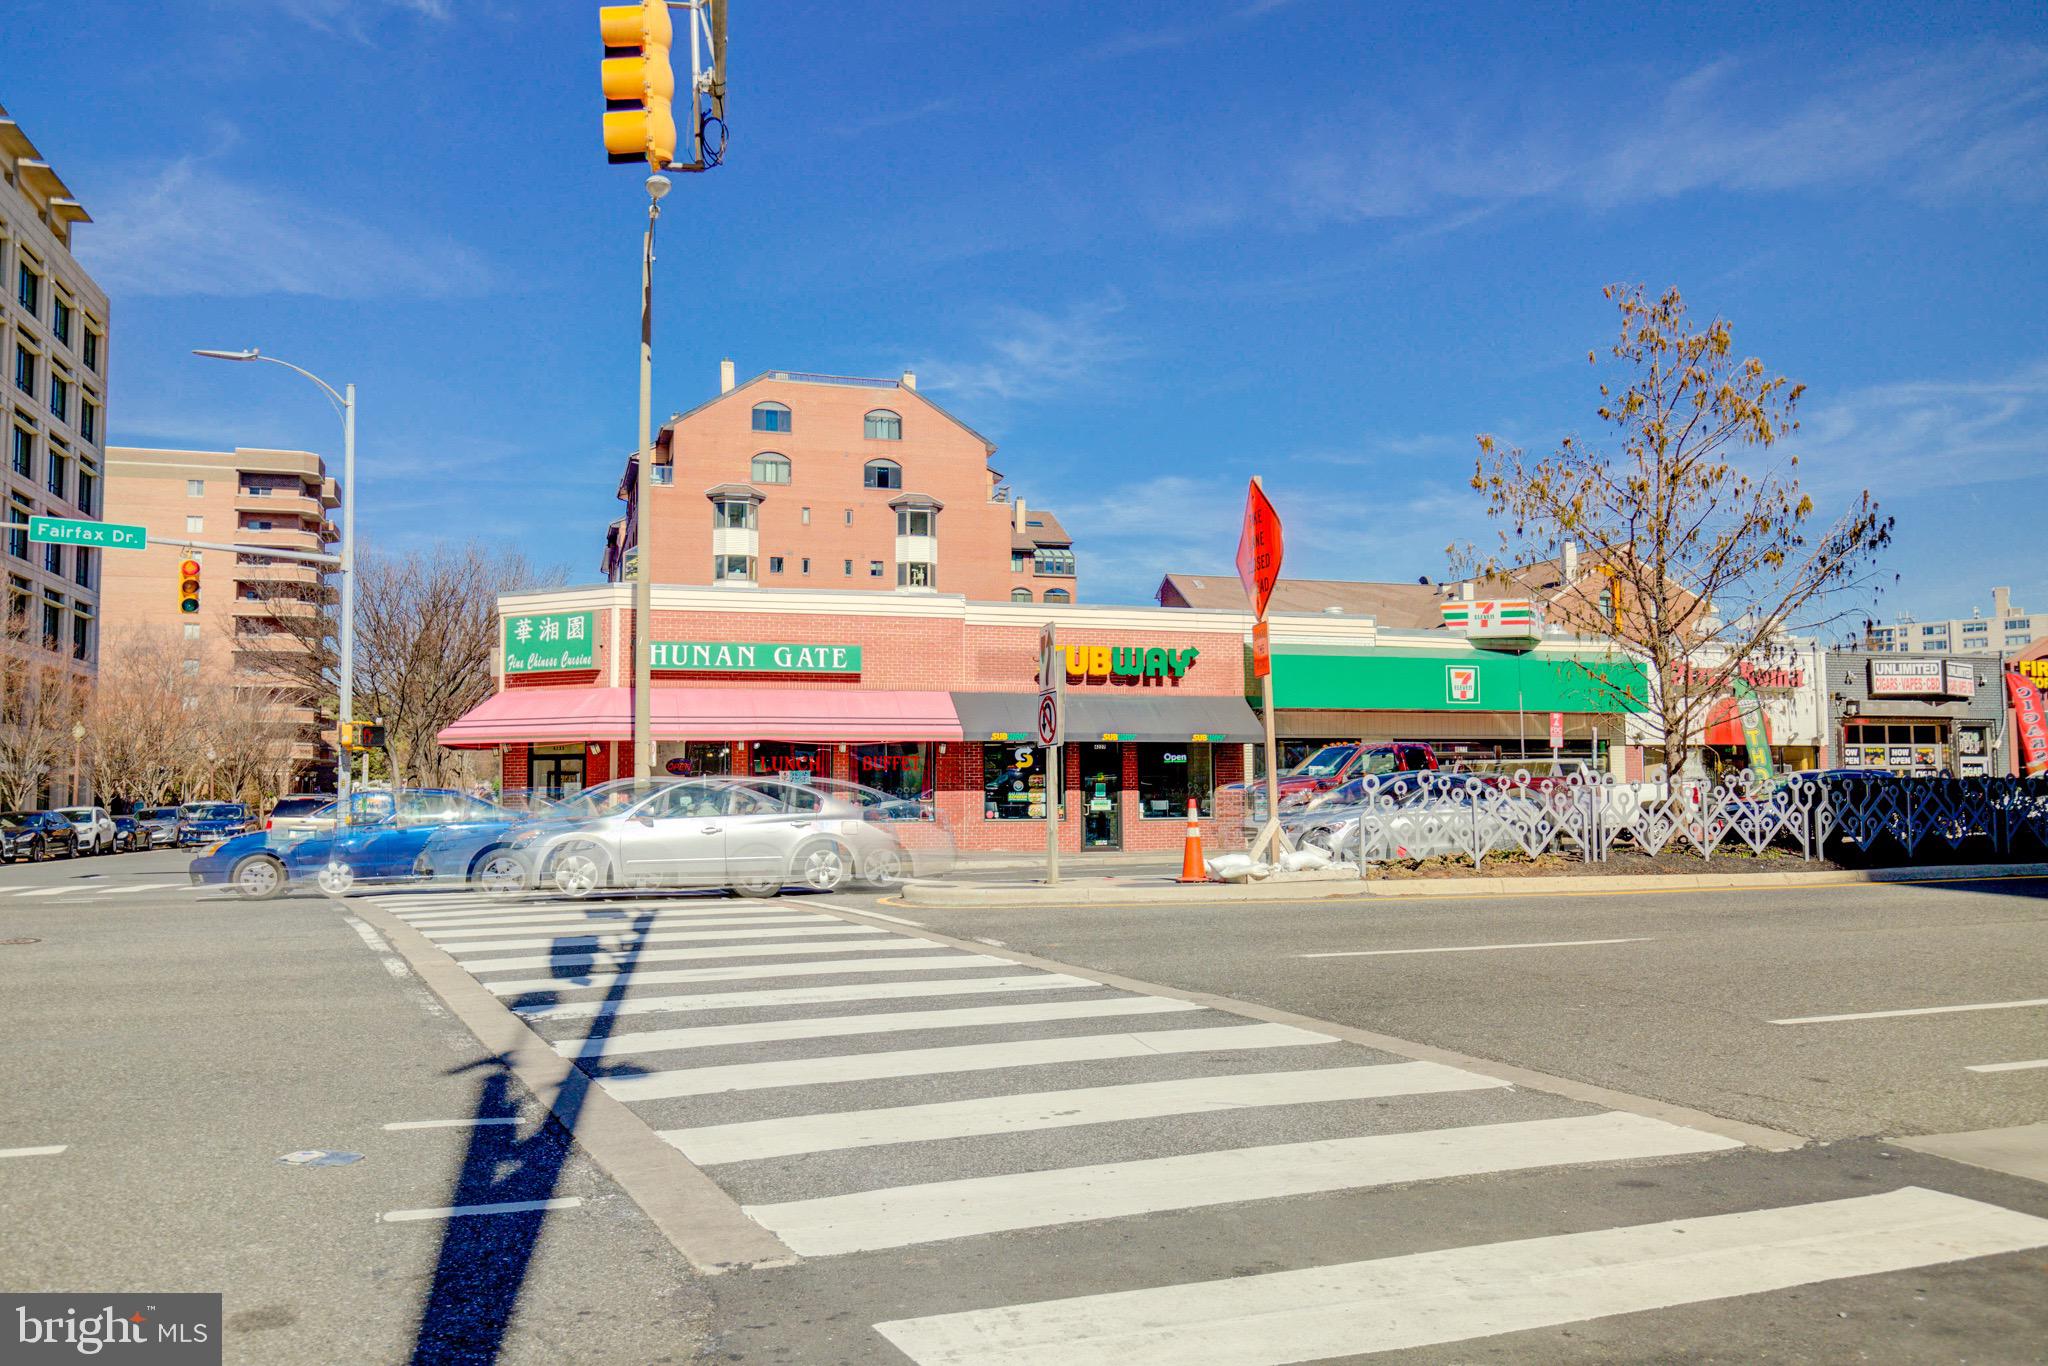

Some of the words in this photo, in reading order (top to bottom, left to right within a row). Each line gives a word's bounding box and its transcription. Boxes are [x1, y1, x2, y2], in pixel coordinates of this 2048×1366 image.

[38, 523, 104, 541] Fairfax
[112, 529, 138, 544] Dr.
[514, 617, 584, 644] 華湘園
[507, 654, 524, 671] Fine
[527, 653, 557, 670] Chinese
[561, 651, 592, 667] Cuisine
[650, 644, 756, 667] HUNAN
[773, 647, 849, 668] GATE
[1056, 646, 1200, 677] UBWAY
[1876, 663, 1939, 675] UNLIMITED
[1875, 677, 1898, 690] CIGARS
[1902, 677, 1923, 690] VAPES
[1926, 677, 1940, 690] CBD
[991, 732, 1028, 741] SUBWAY
[1102, 733, 1136, 741] SUBWAY
[1163, 753, 1187, 761] Open
[1845, 748, 1858, 756] OW
[1891, 748, 1909, 756] NOW
[667, 762, 692, 771] OPEN
[761, 756, 821, 772] LUNCH
[863, 756, 920, 771] BUFFET
